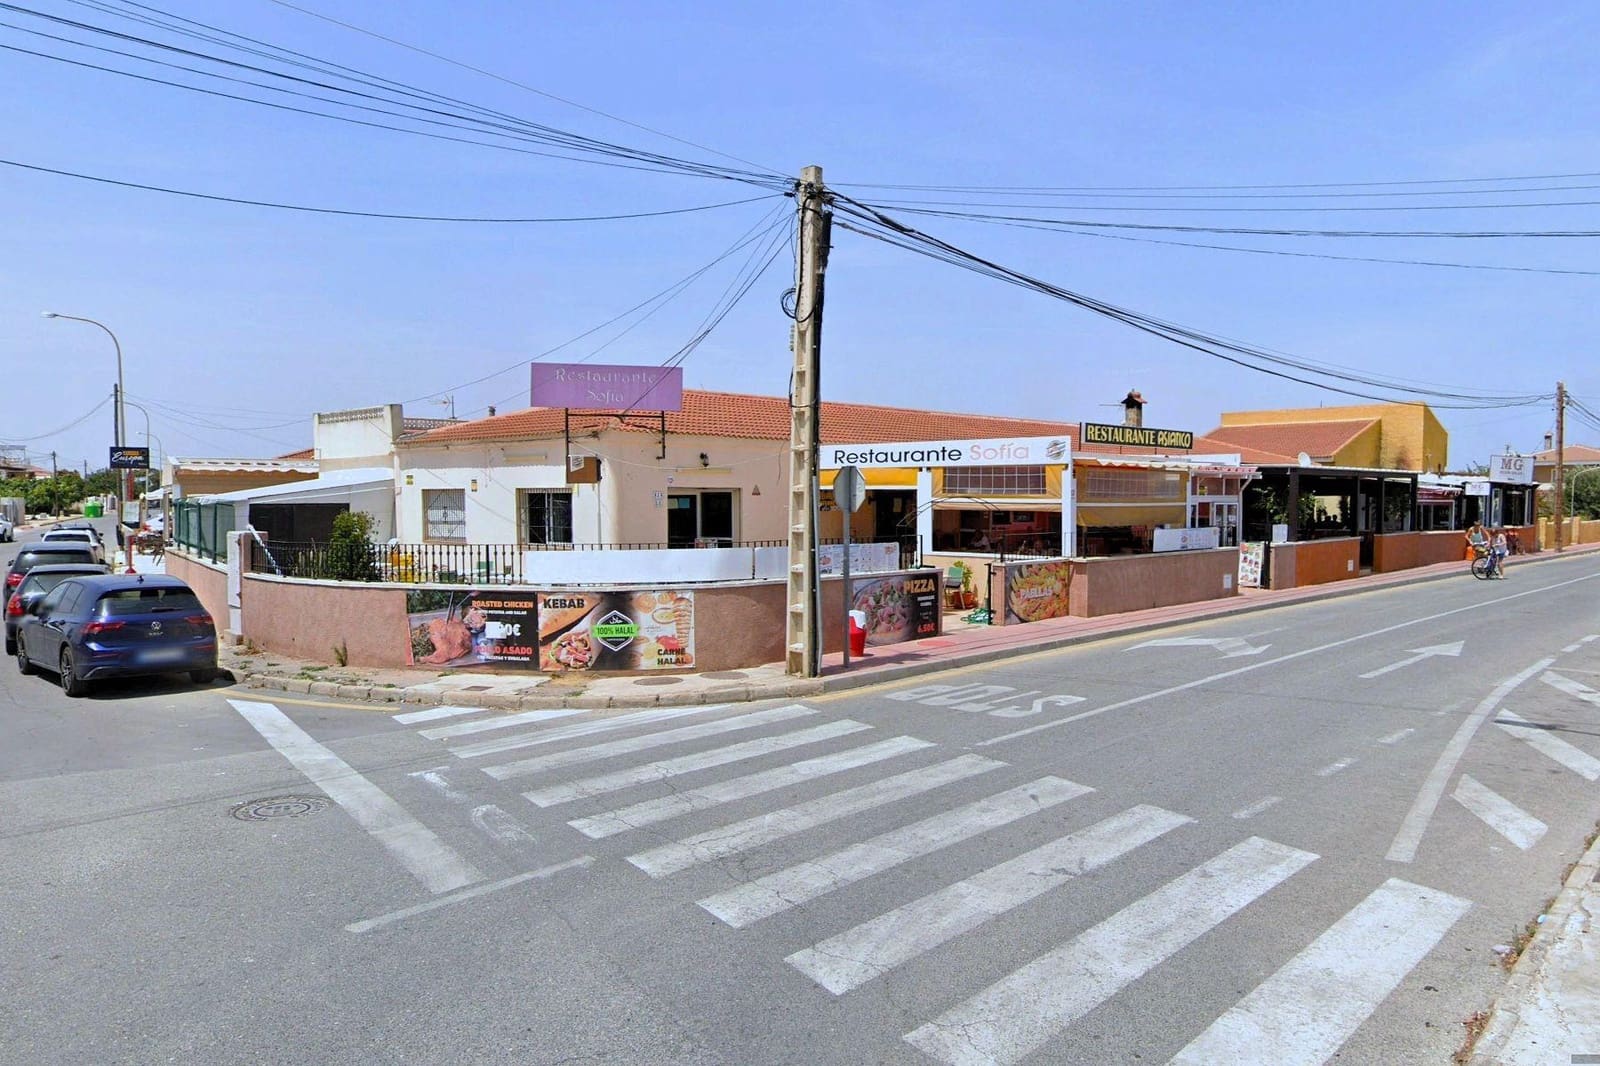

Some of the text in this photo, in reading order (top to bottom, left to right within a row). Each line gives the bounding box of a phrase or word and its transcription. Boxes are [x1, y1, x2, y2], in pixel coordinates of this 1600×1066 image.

[555, 367, 657, 383] Restaurante
[1087, 425, 1156, 445] RESTAURANTE
[834, 443, 1030, 464] Restaurante Sofía
[1500, 458, 1524, 471] MG
[903, 579, 935, 593] PIZZA
[472, 600, 534, 609] ROASTED CHICKEN
[543, 598, 585, 609] KEBAB
[597, 626, 634, 635] 100% HALAL
[502, 646, 533, 655] ASADO
[657, 648, 686, 656] CARNE
